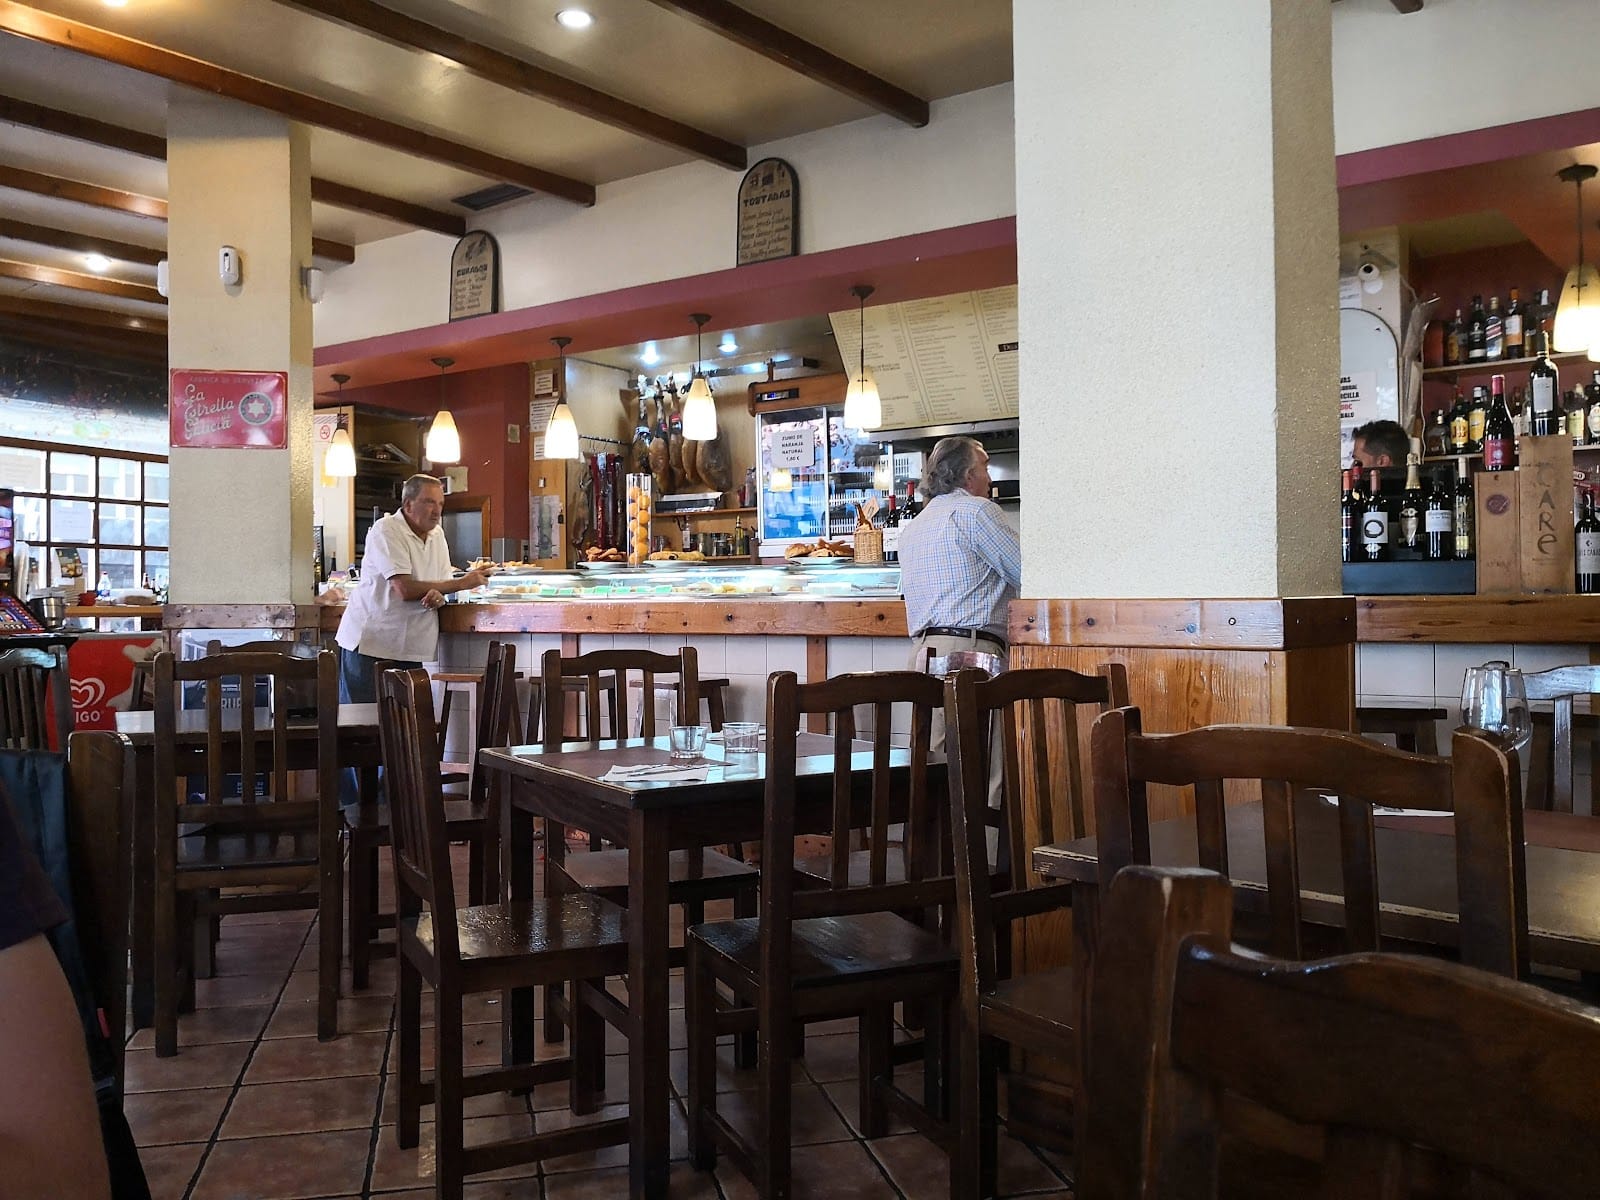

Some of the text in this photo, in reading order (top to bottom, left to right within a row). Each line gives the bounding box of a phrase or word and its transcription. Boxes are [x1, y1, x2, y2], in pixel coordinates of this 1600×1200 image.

[183, 384, 205, 407] La
[183, 397, 235, 423] Estrella
[75, 710, 101, 724] IGO
